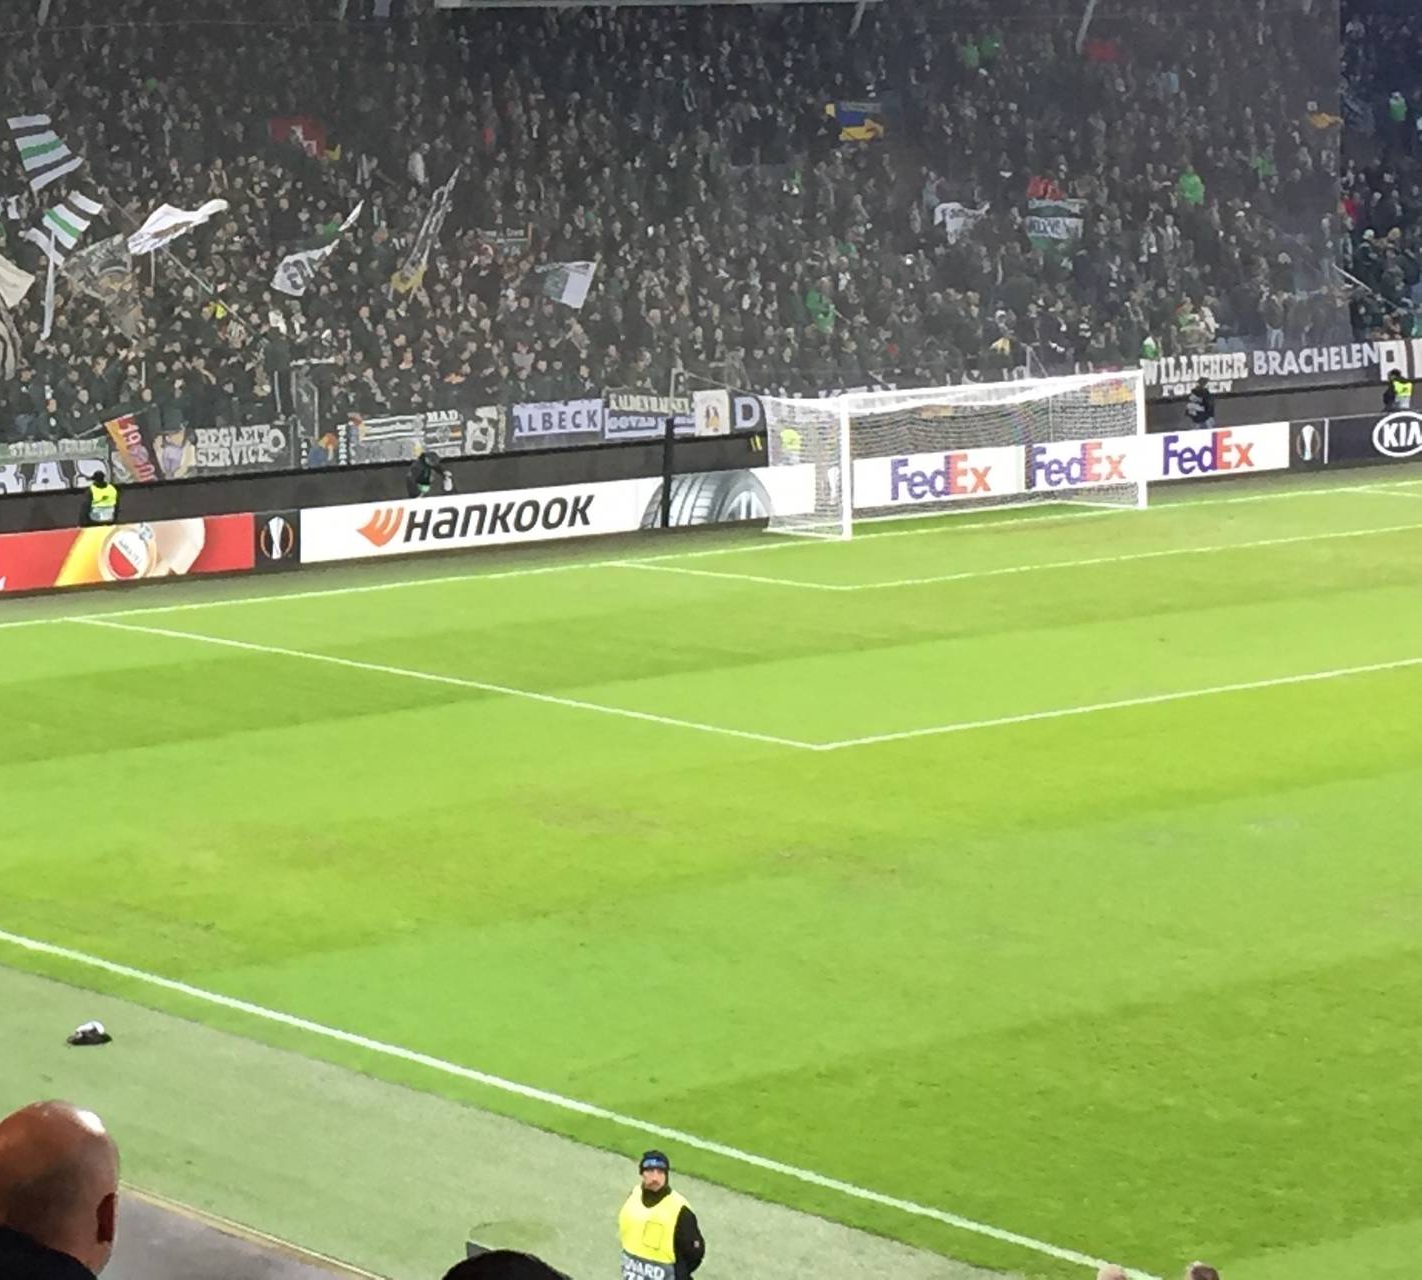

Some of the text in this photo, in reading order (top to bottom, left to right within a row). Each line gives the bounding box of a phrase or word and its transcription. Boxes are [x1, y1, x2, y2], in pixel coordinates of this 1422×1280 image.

[1140, 352, 1249, 385] WILLICHER
[1253, 342, 1381, 376] BRACHELEN
[1383, 421, 1422, 448] KIA
[196, 446, 275, 467] SERVICE
[1030, 442, 1127, 489] FedEx
[1162, 431, 1255, 476] FedEx
[891, 452, 992, 500] FedEx
